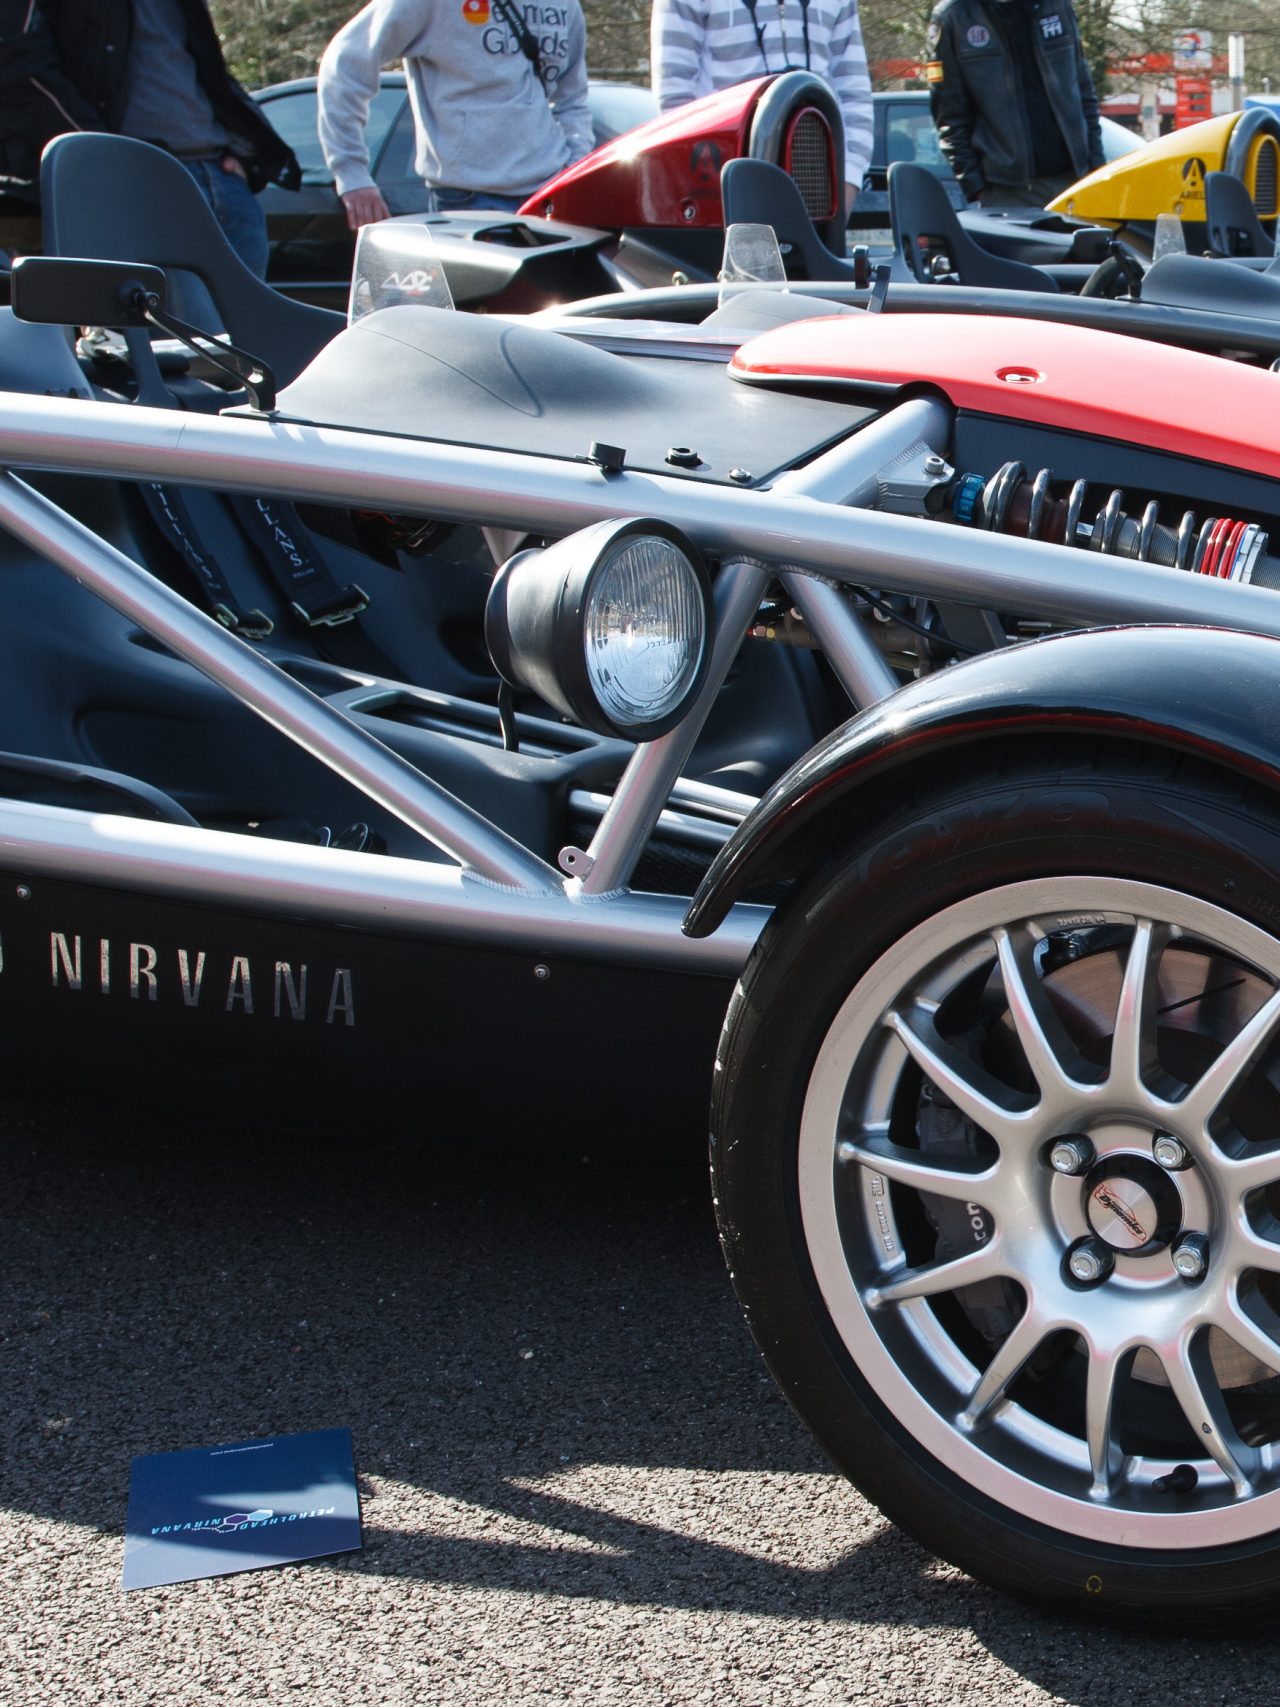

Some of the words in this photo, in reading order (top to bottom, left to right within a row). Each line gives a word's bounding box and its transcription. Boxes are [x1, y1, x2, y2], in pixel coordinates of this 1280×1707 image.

[50, 932, 356, 1027] NIRVANA
[150, 1517, 222, 1536] NIRVANA
[239, 1506, 336, 1531] PETROLHEAD
